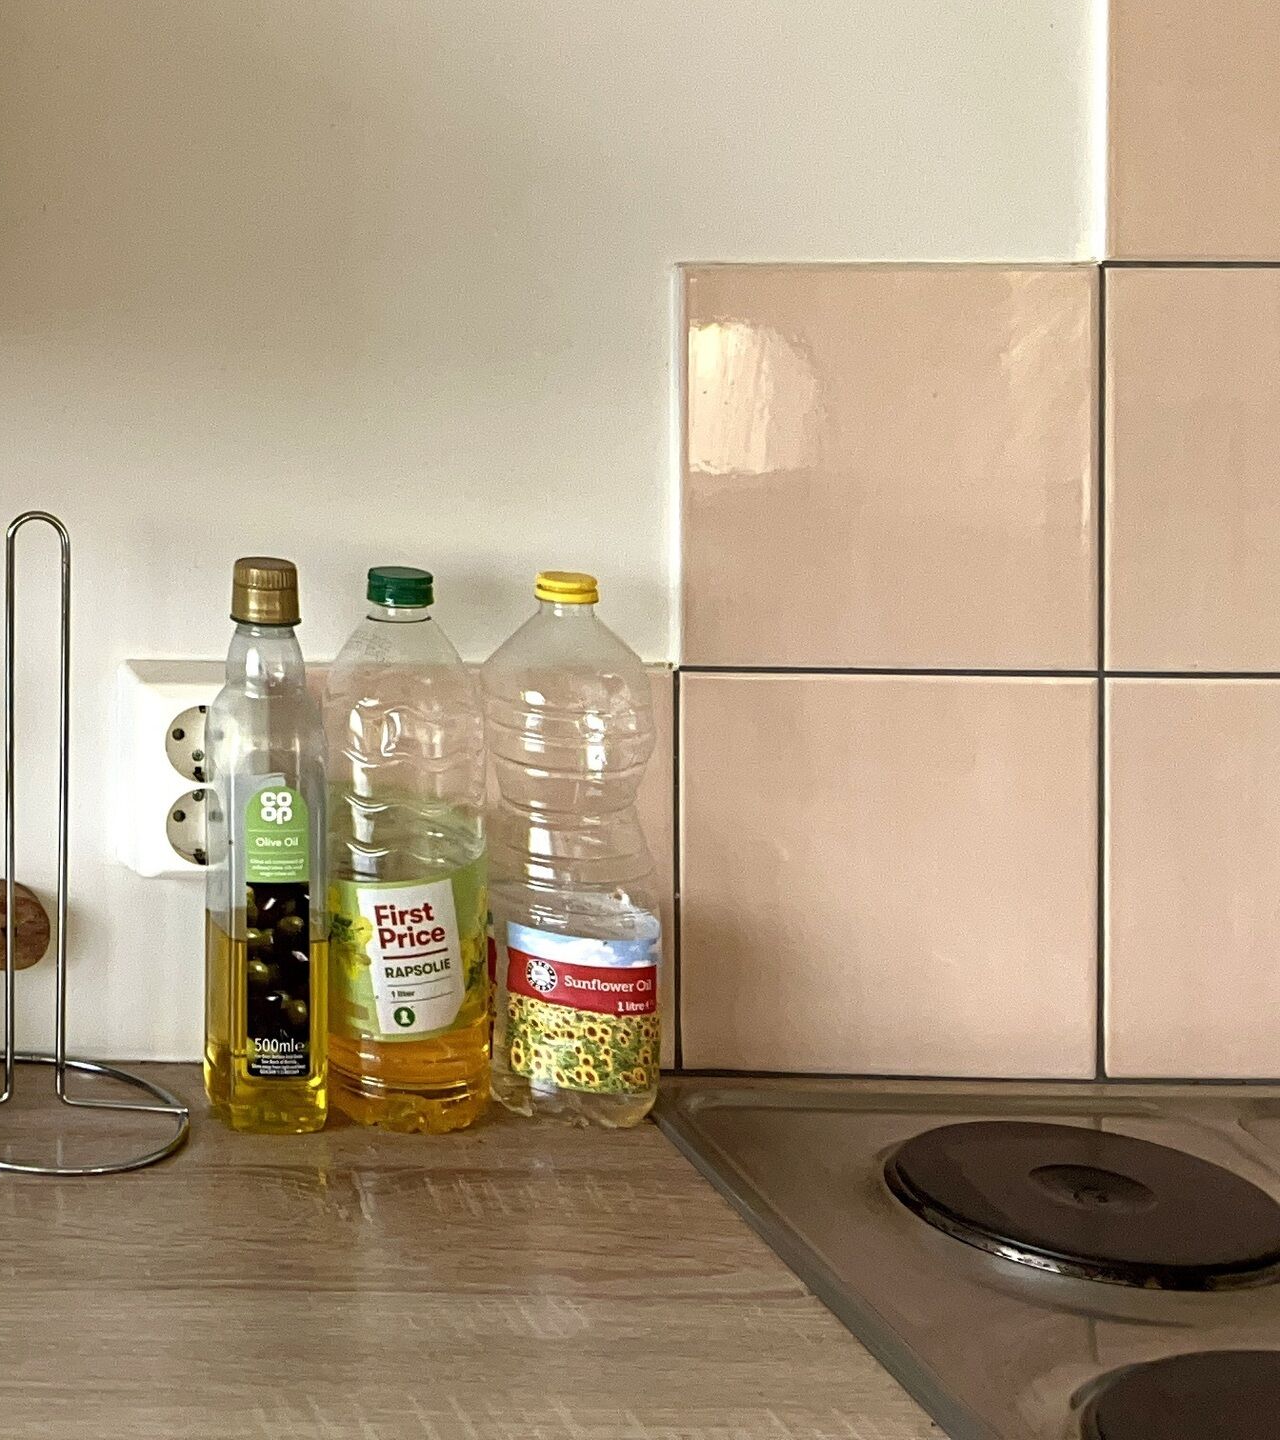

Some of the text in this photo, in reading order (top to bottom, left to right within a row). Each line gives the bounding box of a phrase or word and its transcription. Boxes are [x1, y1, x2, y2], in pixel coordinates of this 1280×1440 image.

[255, 837, 299, 848] Olive Oil
[374, 902, 435, 927] First
[378, 925, 446, 950] Price
[384, 959, 452, 979] RAPSOLIE
[564, 975, 635, 993] Sunflower
[636, 979, 652, 992] Oil
[617, 1001, 625, 1013] 1
